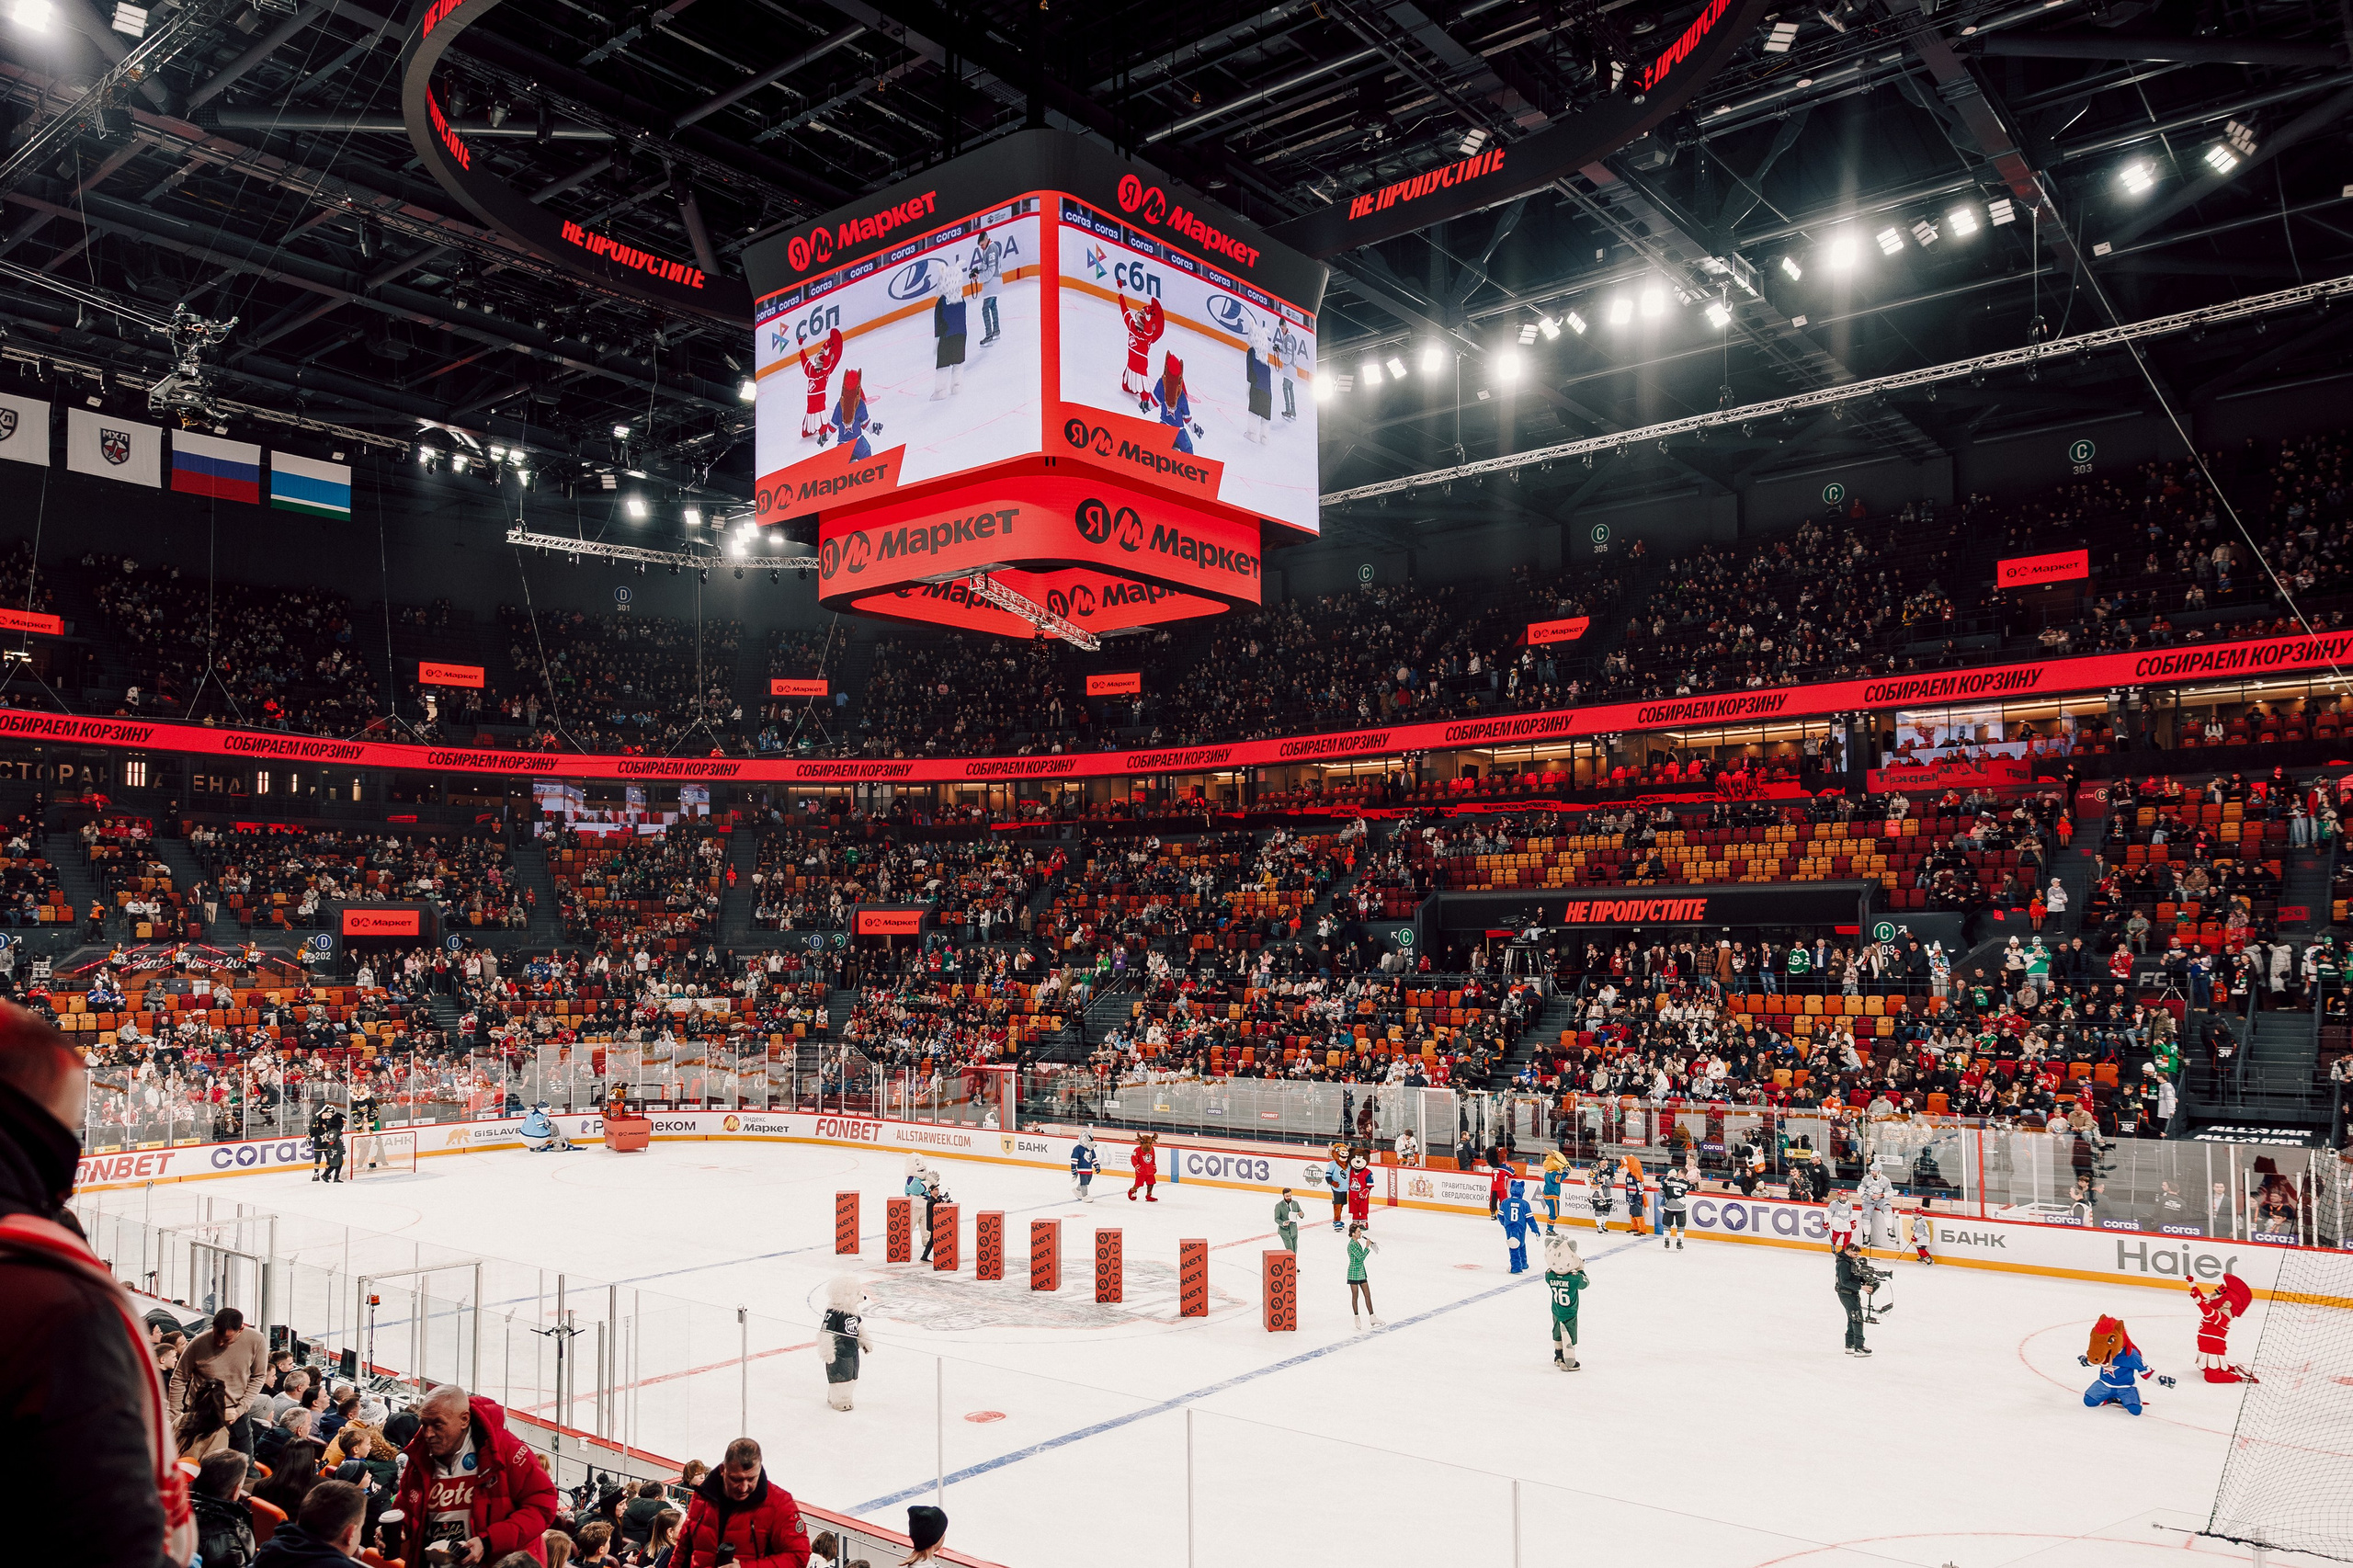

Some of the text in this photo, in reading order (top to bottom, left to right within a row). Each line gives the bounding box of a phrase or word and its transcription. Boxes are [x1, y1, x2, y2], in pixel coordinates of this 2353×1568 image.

[1348, 148, 1506, 221] НЕ ПРОПУСТИТЕ
[837, 190, 937, 250] Маркет
[1166, 206, 1260, 268] Маркет
[562, 220, 705, 290] НЕ ПРОПУСТИТЕ
[1114, 261, 1161, 299] сбп
[795, 304, 840, 341] сбп
[1118, 441, 1210, 483] Маркет
[2073, 462, 2093, 475] 303
[797, 464, 888, 501] Маркет
[877, 508, 1019, 561] Маркет
[1149, 524, 1259, 579] Маркет
[1594, 545, 1608, 553] 305
[617, 604, 631, 612] 301
[2135, 647, 2248, 676] СОБИРАЕМ
[1864, 668, 2042, 702] СОБИРАЕМ КОРЗИНУ
[1638, 694, 1788, 724] СОБИРАЕМ КОРЗИНУ
[79, 722, 154, 743] КОРЗИНУ
[1445, 715, 1574, 741] СОБИРАЕМ КОРЗИНУ
[224, 735, 364, 760] СОБИРАЕМ КОРЗИНУ
[1279, 733, 1391, 756] СОБИРАЕМ КОРЗИНУ
[427, 752, 559, 771] СОБИРАЕМ КОРЗИНУ
[618, 761, 740, 777] СОБИРАЕМ КОРЗИНУ
[966, 759, 1076, 776] СОБИРАЕМ КОРЗИНУ
[1127, 749, 1232, 768] СОБИРАЕМ КОРЗИНУ
[796, 764, 913, 777] СОБИРАЕМ КОРЗИНУ
[1564, 899, 1708, 922] НЕ ПРОПУСТИТЕ
[315, 951, 332, 960] 202
[743, 1115, 767, 1124] Яндекс
[743, 1123, 790, 1134] Маркет
[815, 1119, 882, 1142] FONBET
[385, 1135, 414, 1147] АНК
[1017, 1142, 1048, 1153] БАНК
[210, 1142, 315, 1169] согаз
[74, 1152, 176, 1185] ONBET
[1187, 1153, 1269, 1182] согаз
[1441, 1181, 1487, 1192] ПРАВИТЕЛЬСТВО
[1441, 1190, 1484, 1201] СВЕРДЛОВСКОЙ
[1691, 1199, 1829, 1240] согаз
[2046, 1215, 2082, 1226] согаз
[2103, 1220, 2140, 1231] согаз
[2162, 1225, 2200, 1236] согаз
[1940, 1229, 2007, 1249] БАНК
[2117, 1239, 2238, 1278] Haier
[1552, 1288, 1571, 1307] 16
